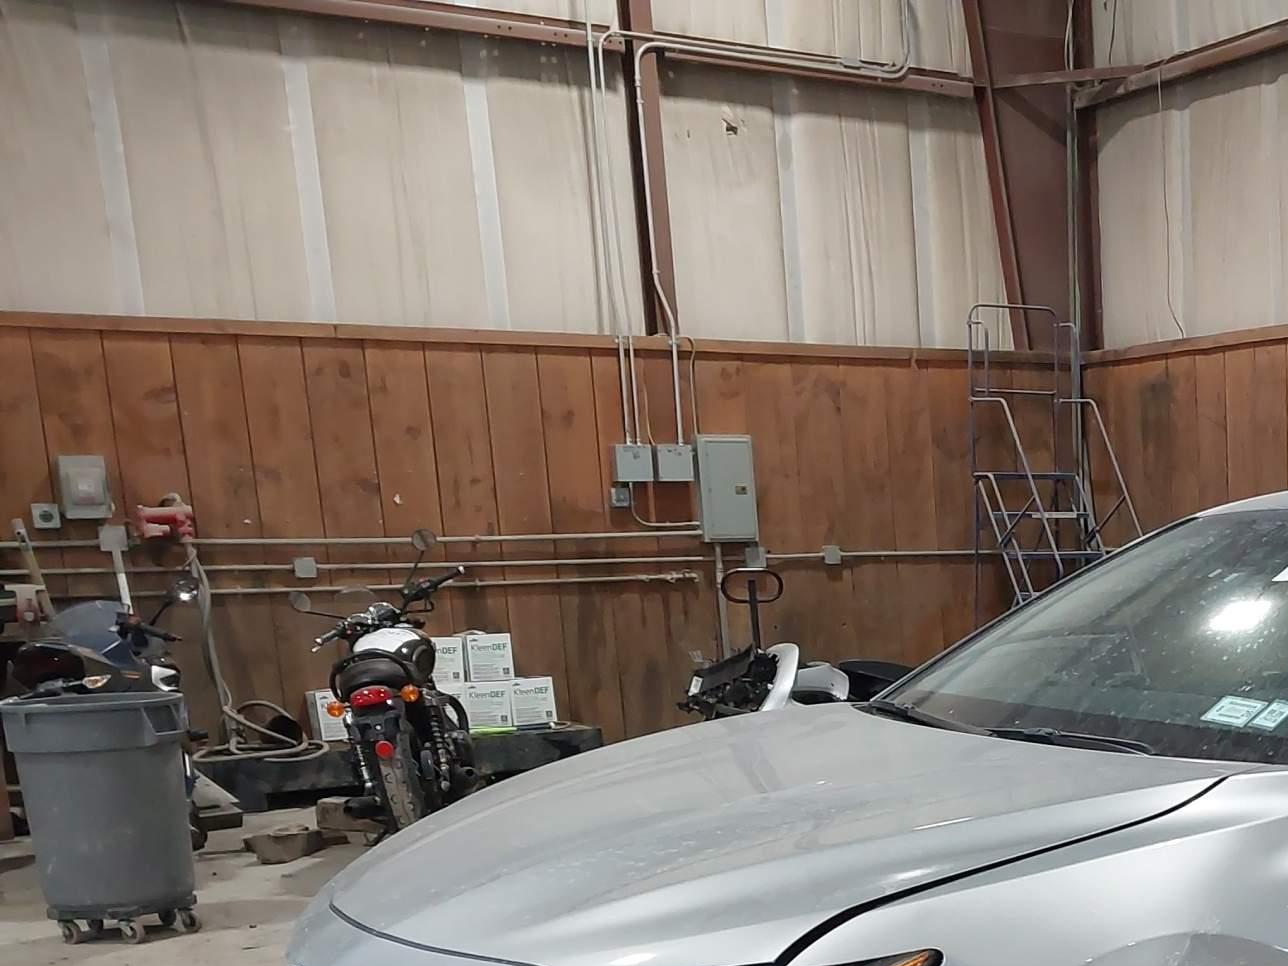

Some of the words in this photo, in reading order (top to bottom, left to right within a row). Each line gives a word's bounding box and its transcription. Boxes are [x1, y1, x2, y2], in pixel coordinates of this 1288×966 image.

[471, 642, 507, 652] KleenDEF
[469, 690, 505, 699] KleenDEF
[513, 686, 549, 696] KleenDEF
